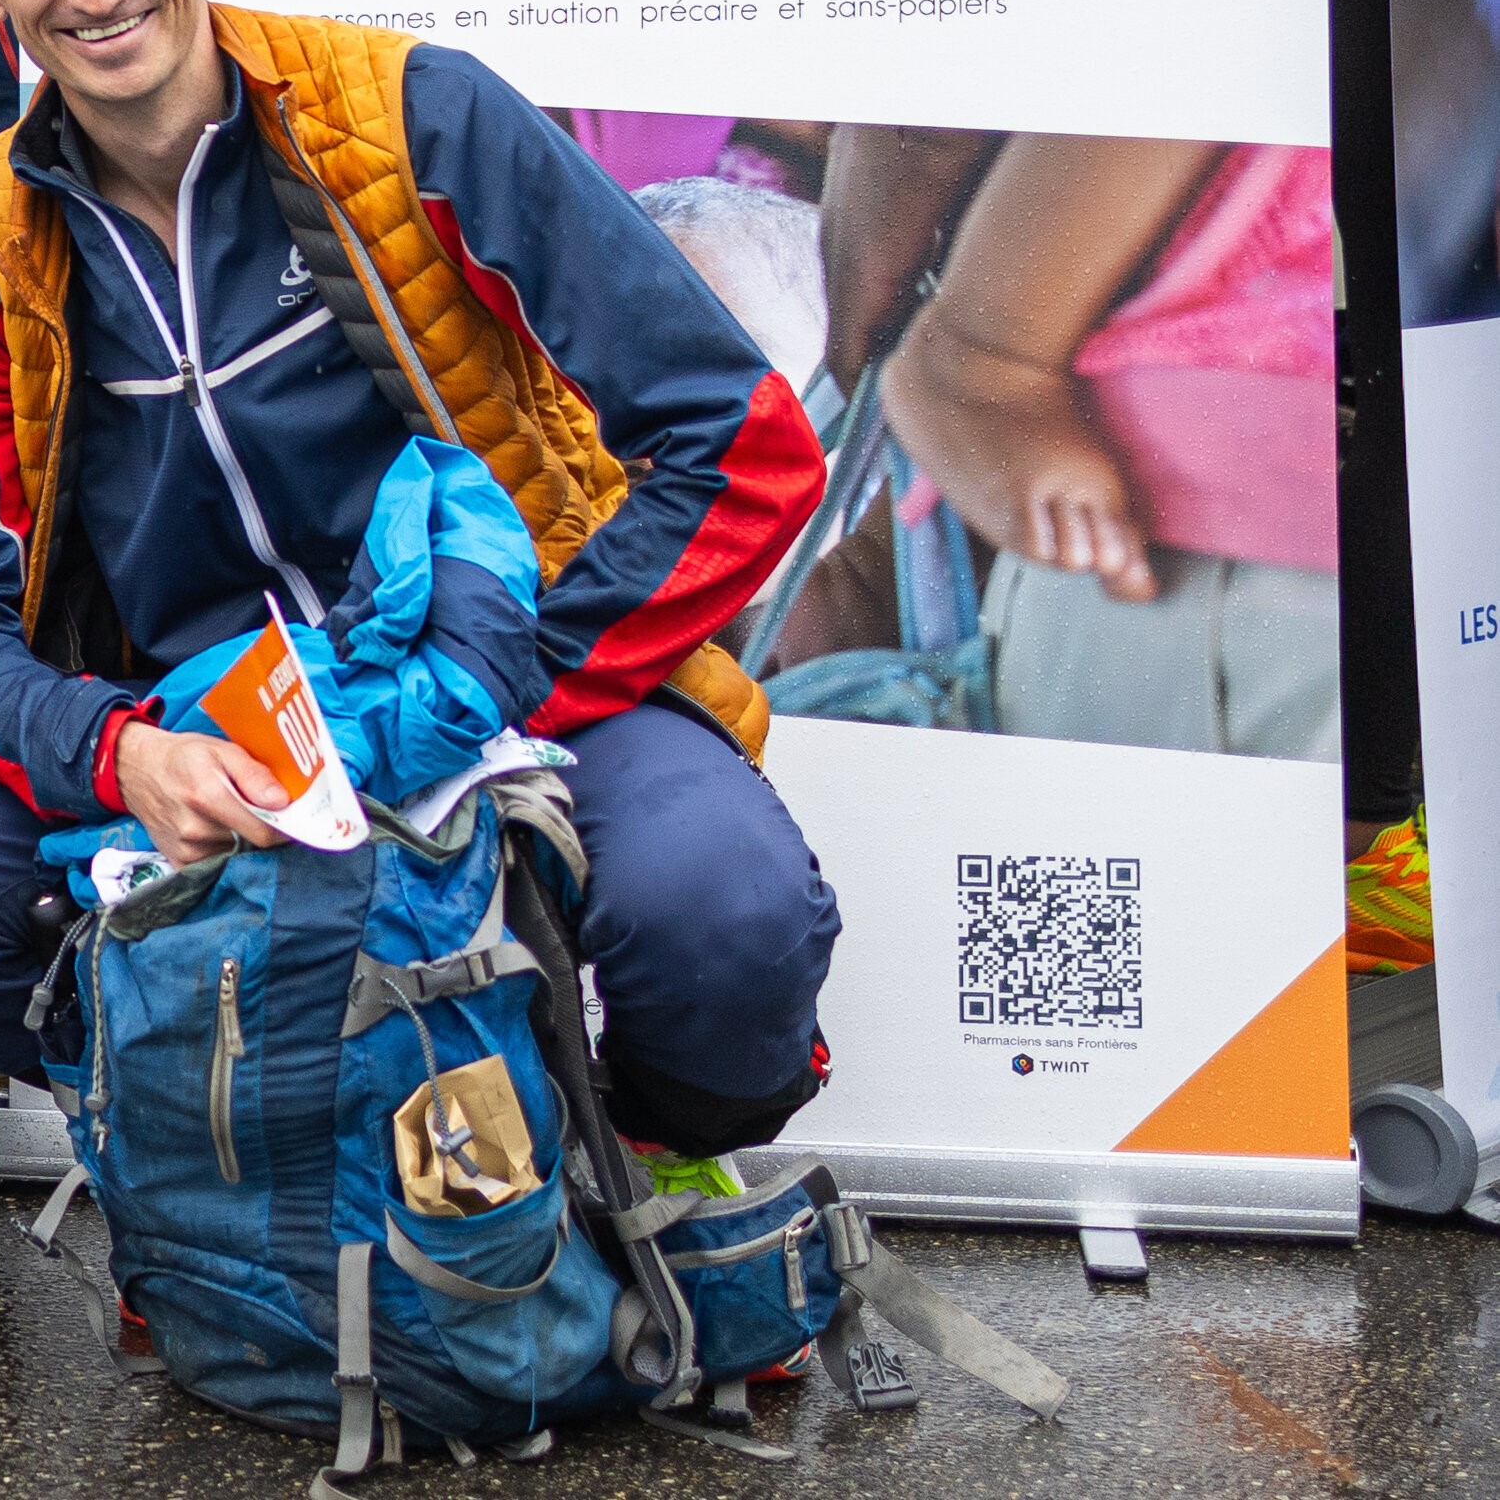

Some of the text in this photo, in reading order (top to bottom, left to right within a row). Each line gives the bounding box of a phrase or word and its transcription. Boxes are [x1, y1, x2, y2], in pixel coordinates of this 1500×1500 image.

[455, 11, 487, 27] en
[508, 1, 618, 26] situation
[1460, 604, 1498, 645] LES
[964, 1034, 1137, 1050] Pharmaciens sans Frontières
[1039, 1060, 1090, 1073] TWINT
